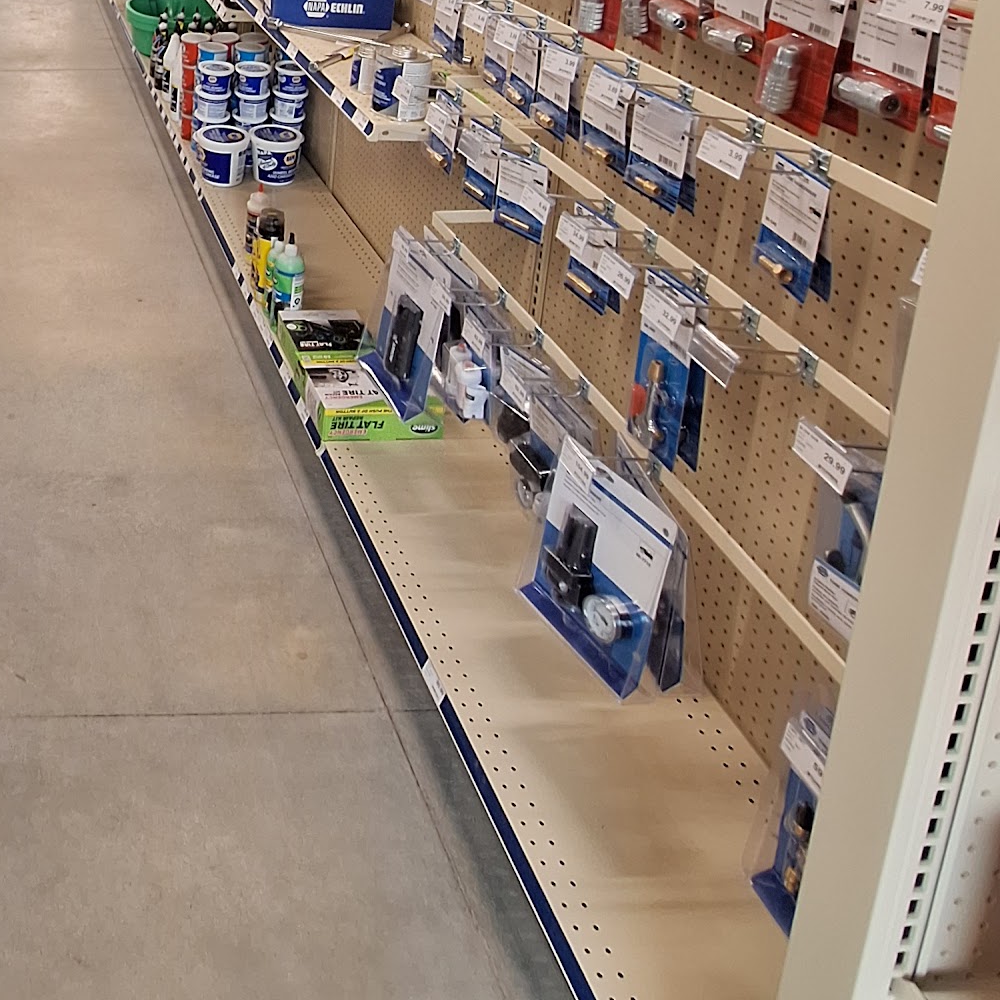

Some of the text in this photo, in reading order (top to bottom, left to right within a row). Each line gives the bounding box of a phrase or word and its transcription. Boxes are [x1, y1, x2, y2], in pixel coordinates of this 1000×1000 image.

[307, 1, 326, 13] NAPA
[924, 1, 944, 13] 7.99
[330, 420, 384, 429] FLAT TIRE
[823, 451, 846, 476] 29.99
